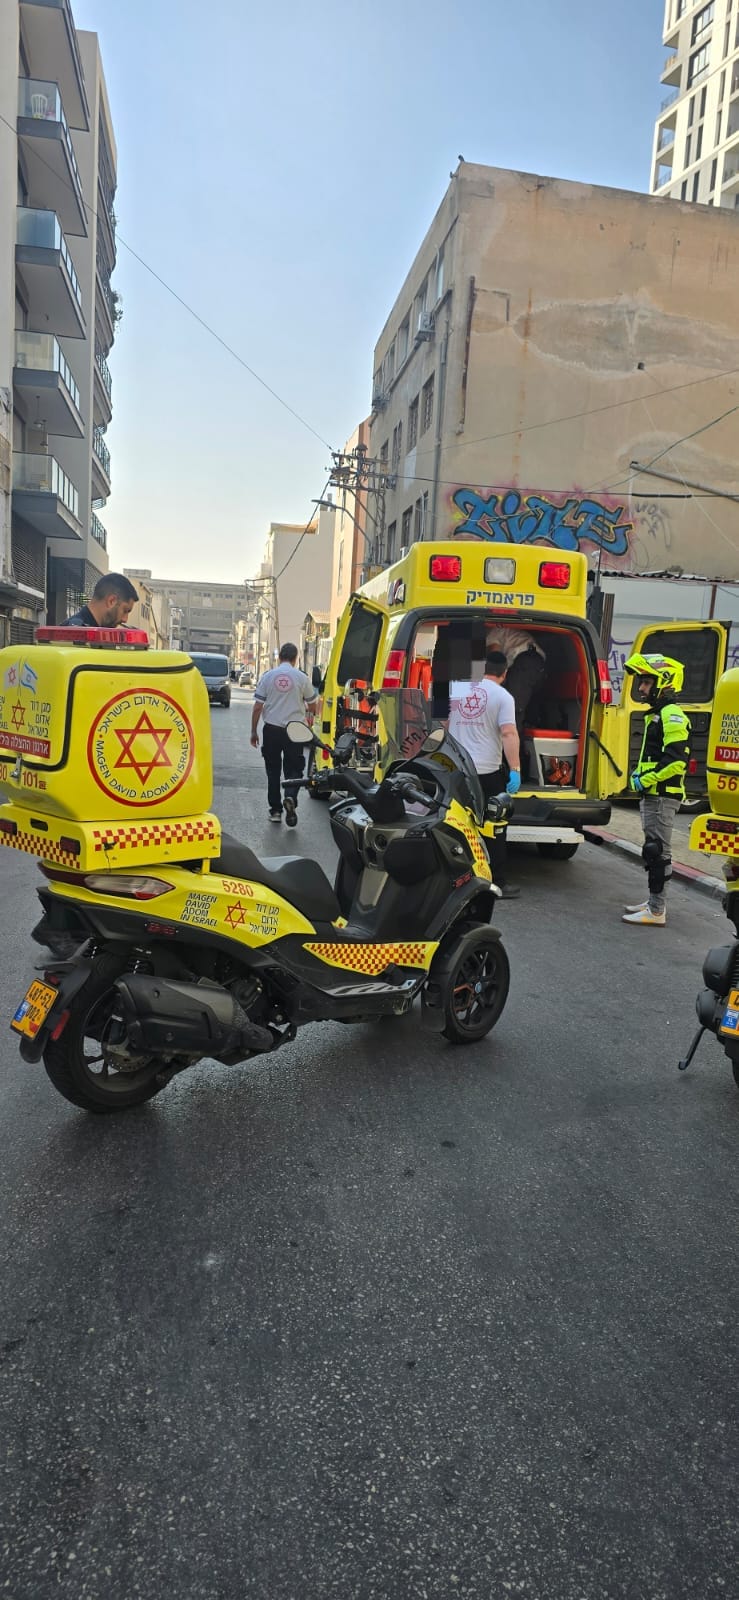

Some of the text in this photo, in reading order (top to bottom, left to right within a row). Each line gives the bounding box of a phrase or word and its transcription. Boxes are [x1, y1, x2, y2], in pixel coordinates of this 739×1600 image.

[466, 590, 535, 606] פראמדיק
[36, 714, 50, 726] אדום
[97, 695, 186, 734] מגן דוד אדום בישראל
[27, 722, 49, 738] בישראל
[96, 737, 188, 799] MAGEN DAVID ADOM IN ISRAEL
[22, 770, 38, 788] 101
[717, 774, 738, 791] 56
[221, 880, 254, 897] 5280
[188, 892, 217, 904] MAGEN
[183, 906, 209, 917] ADOM
[185, 900, 211, 910] DAVID
[256, 903, 280, 915] מגן דוד
[180, 913, 218, 926] IN ISRAEL
[261, 915, 278, 925] אדום
[249, 922, 277, 935] בישראל
